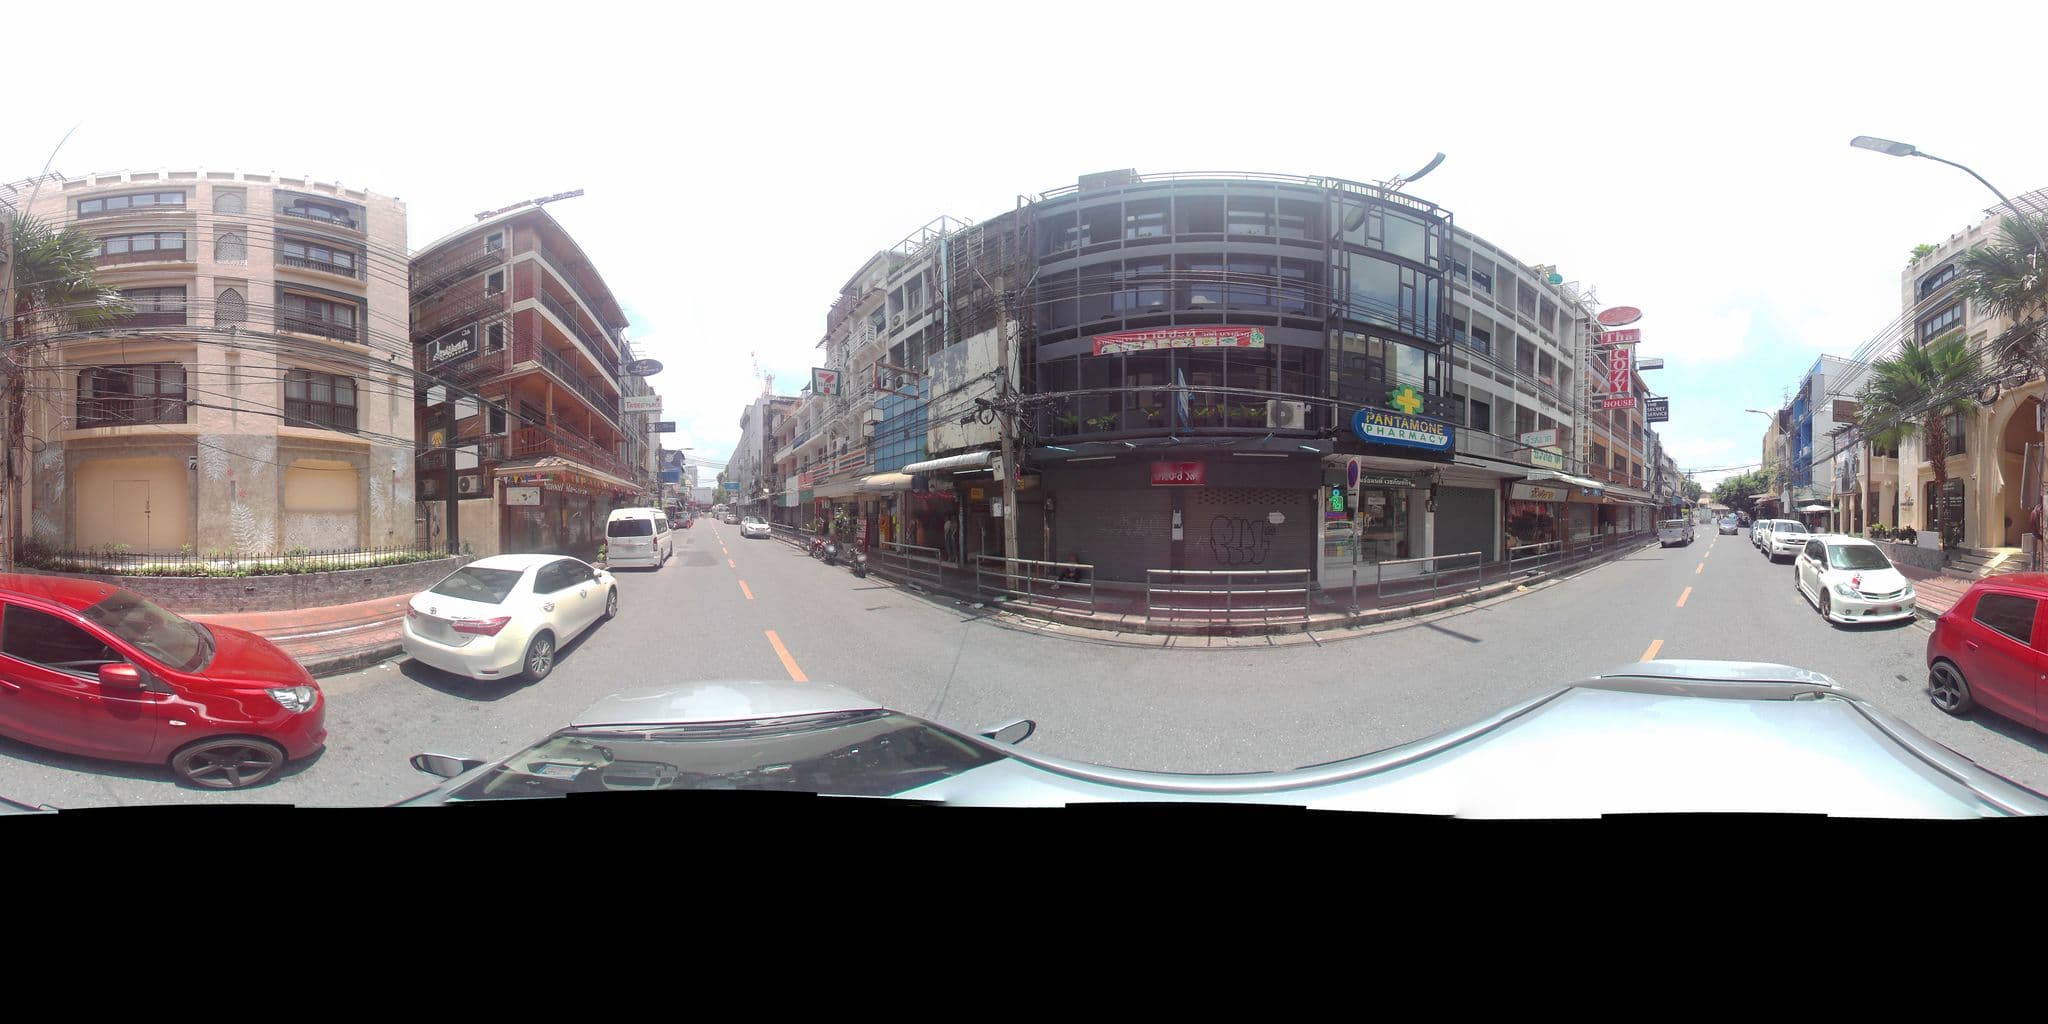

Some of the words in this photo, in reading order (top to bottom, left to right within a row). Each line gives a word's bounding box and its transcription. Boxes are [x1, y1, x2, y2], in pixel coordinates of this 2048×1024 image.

[1613, 350, 1627, 392] COZY
[1366, 411, 1444, 435] PANTAMONE
[1366, 425, 1444, 443] PHARMACY
